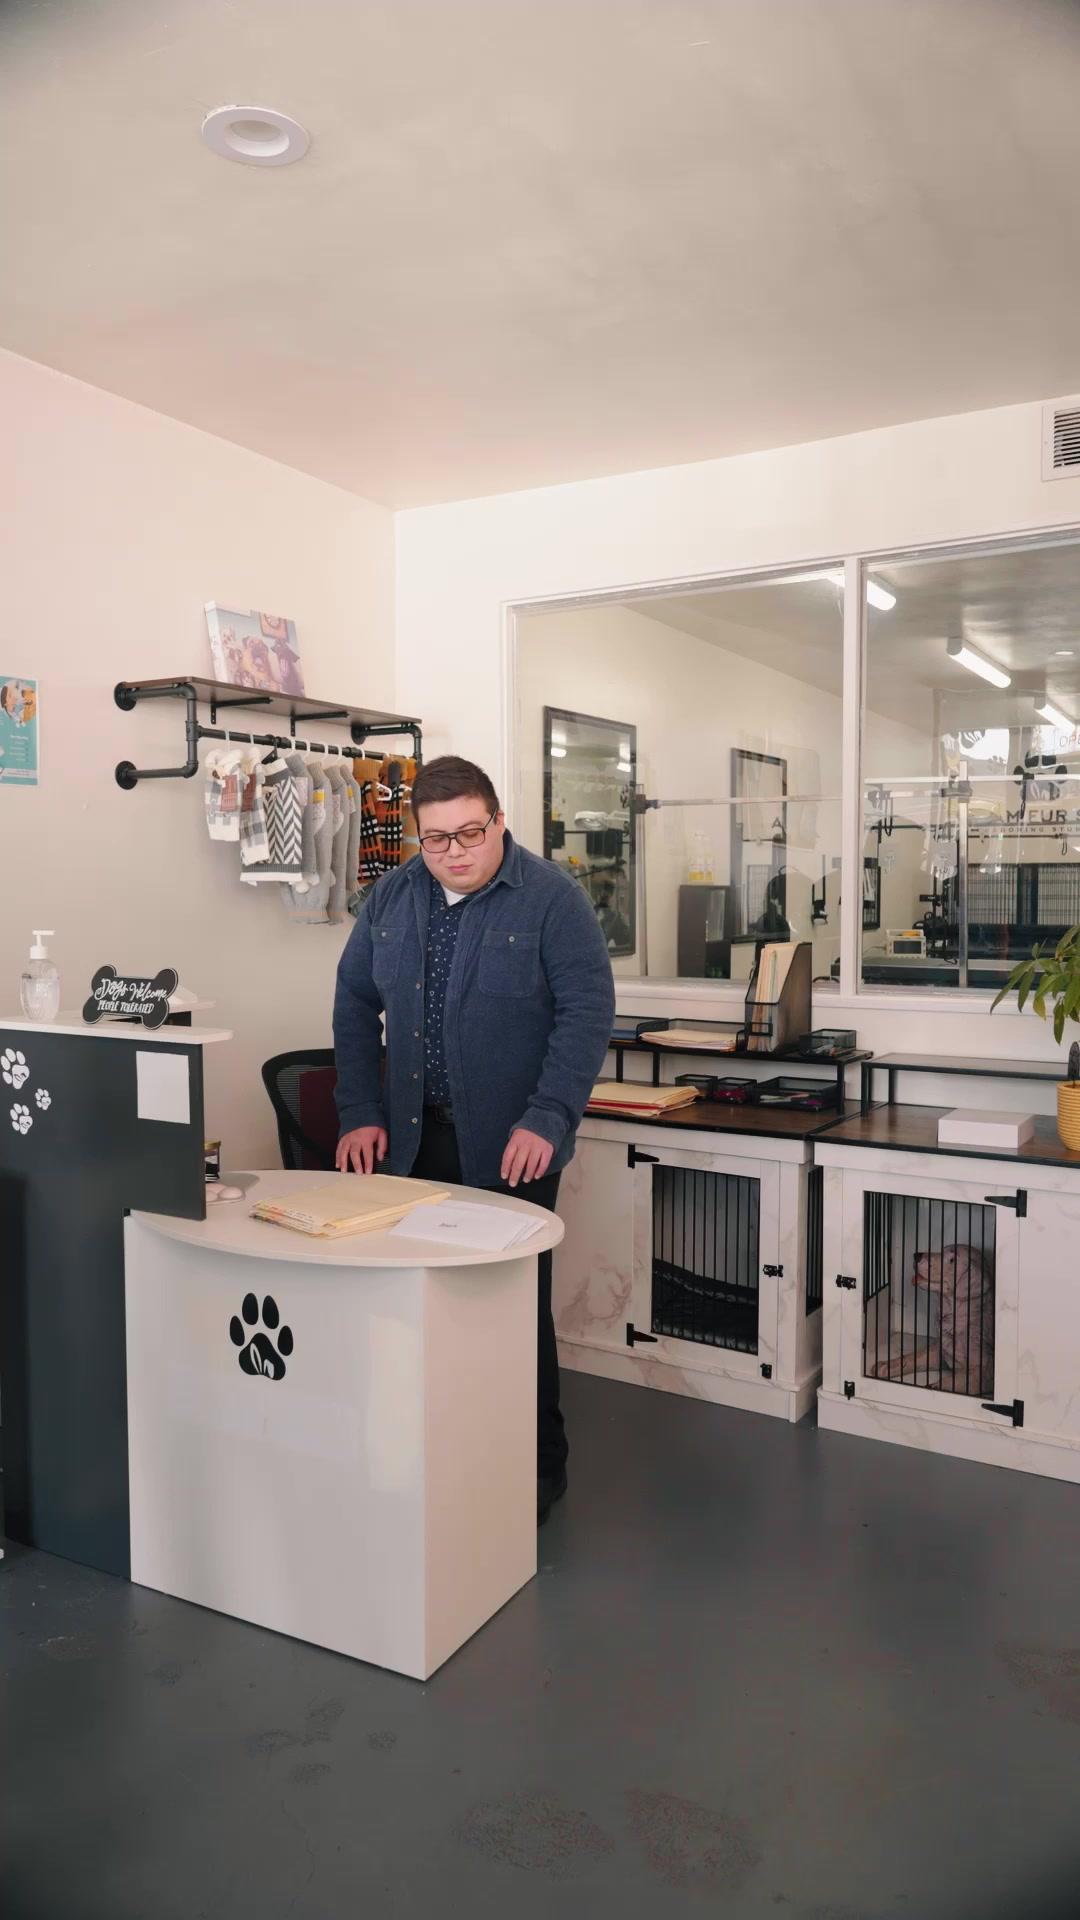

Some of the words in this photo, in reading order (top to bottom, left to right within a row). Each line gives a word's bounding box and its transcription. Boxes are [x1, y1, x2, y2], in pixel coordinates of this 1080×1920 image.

[94, 978, 129, 1000] Dogs
[129, 982, 167, 1002] Welcome
[97, 1000, 120, 1011] PEOPLE
[120, 1001, 155, 1014] TOLERATED
